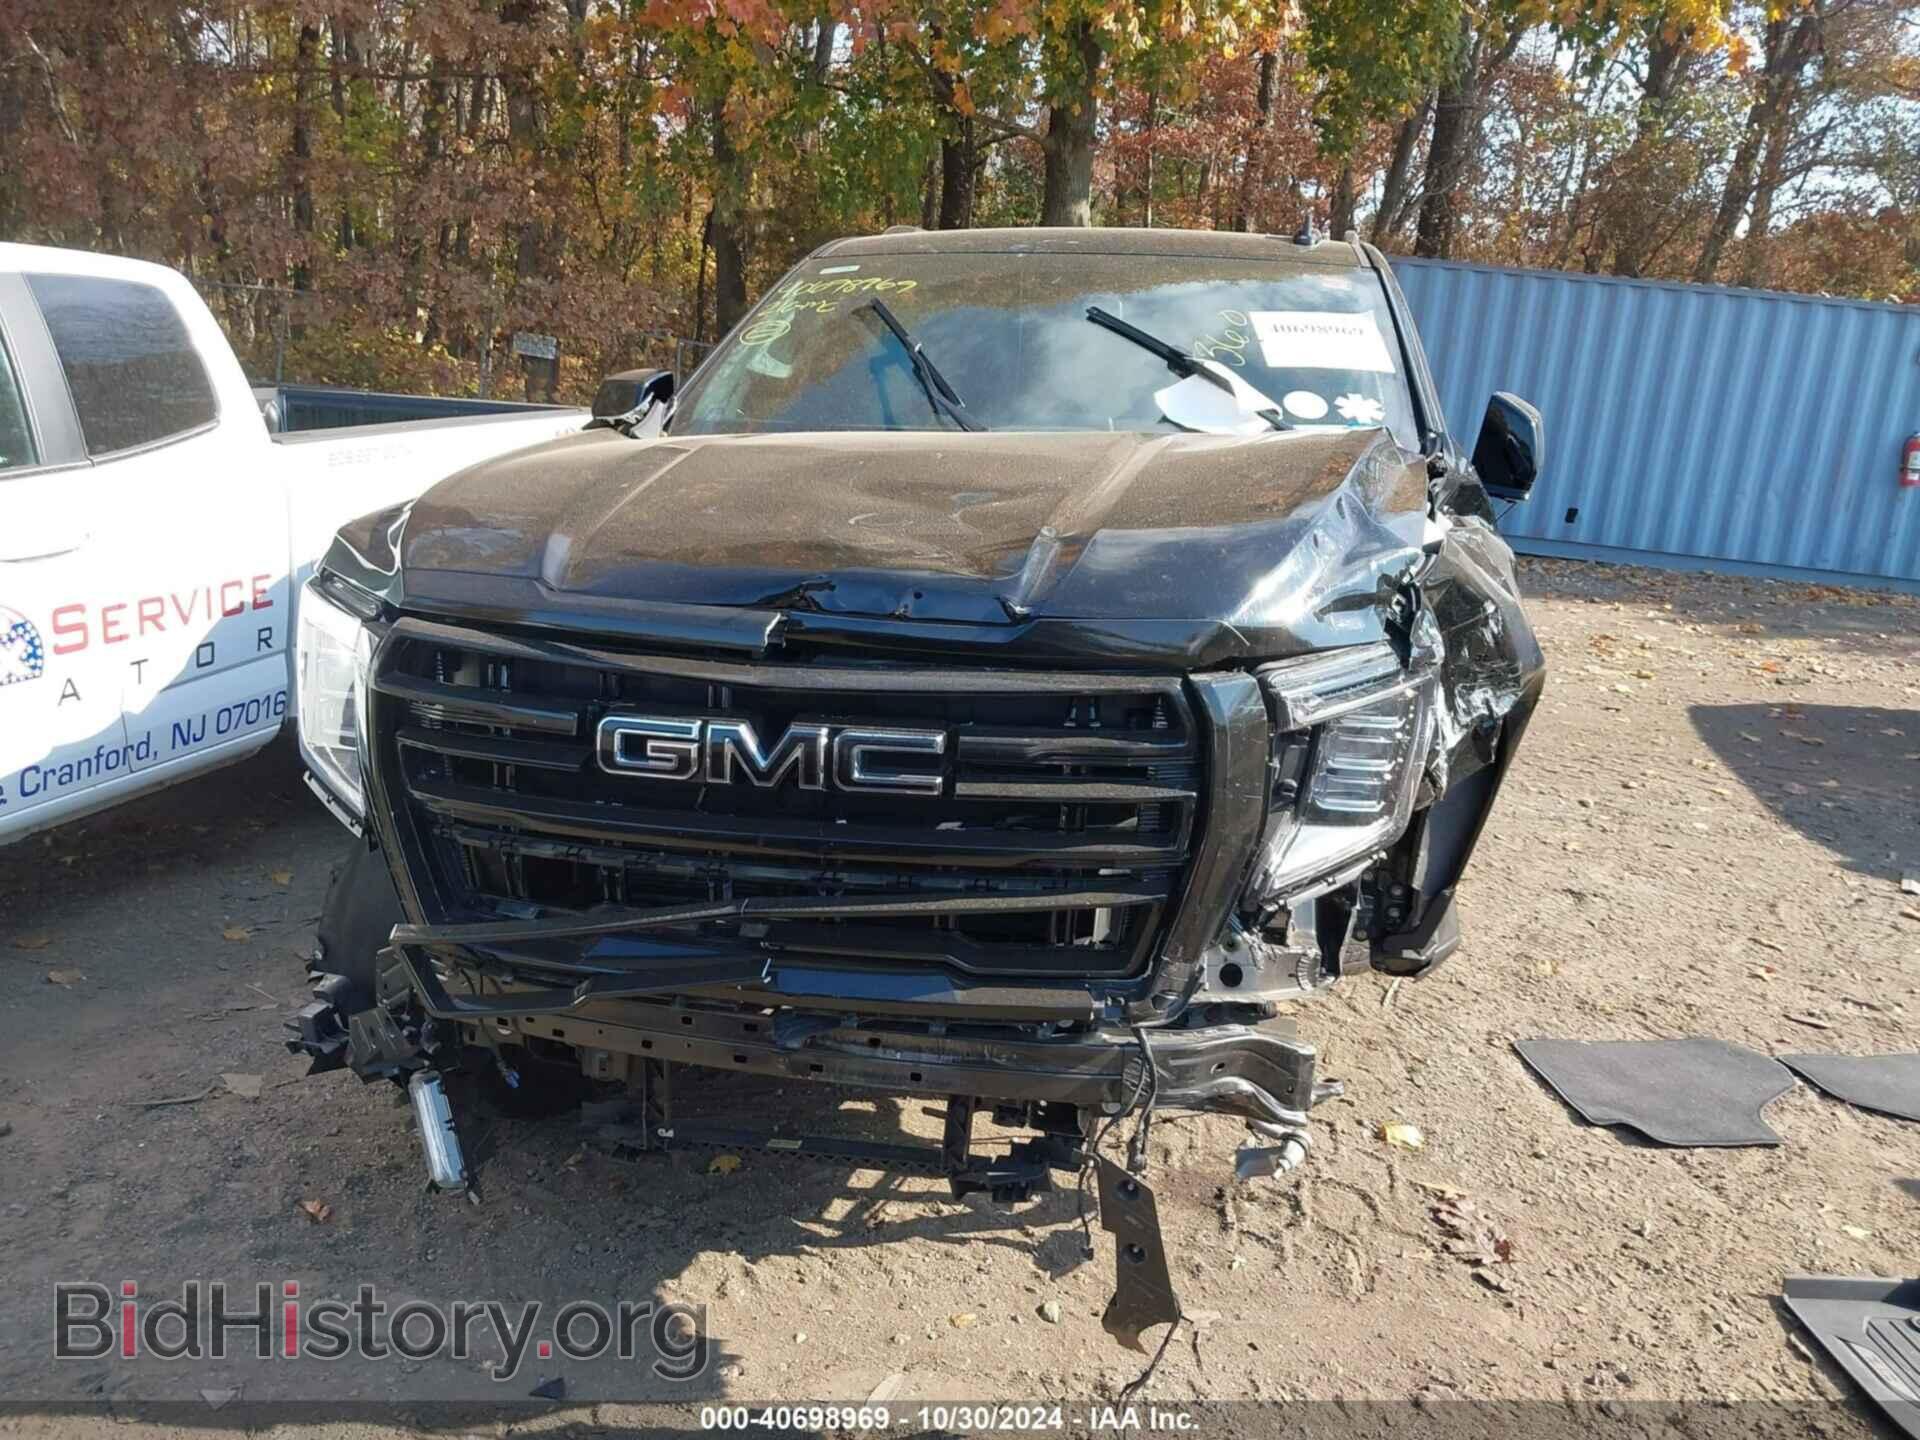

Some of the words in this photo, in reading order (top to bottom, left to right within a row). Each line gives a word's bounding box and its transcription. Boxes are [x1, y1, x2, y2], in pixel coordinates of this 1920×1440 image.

[52, 574, 273, 655] SERVICE
[19, 732, 158, 798] Cranford,
[171, 714, 206, 750] NJ
[215, 690, 287, 736] 07016
[597, 715, 946, 796] GMC
